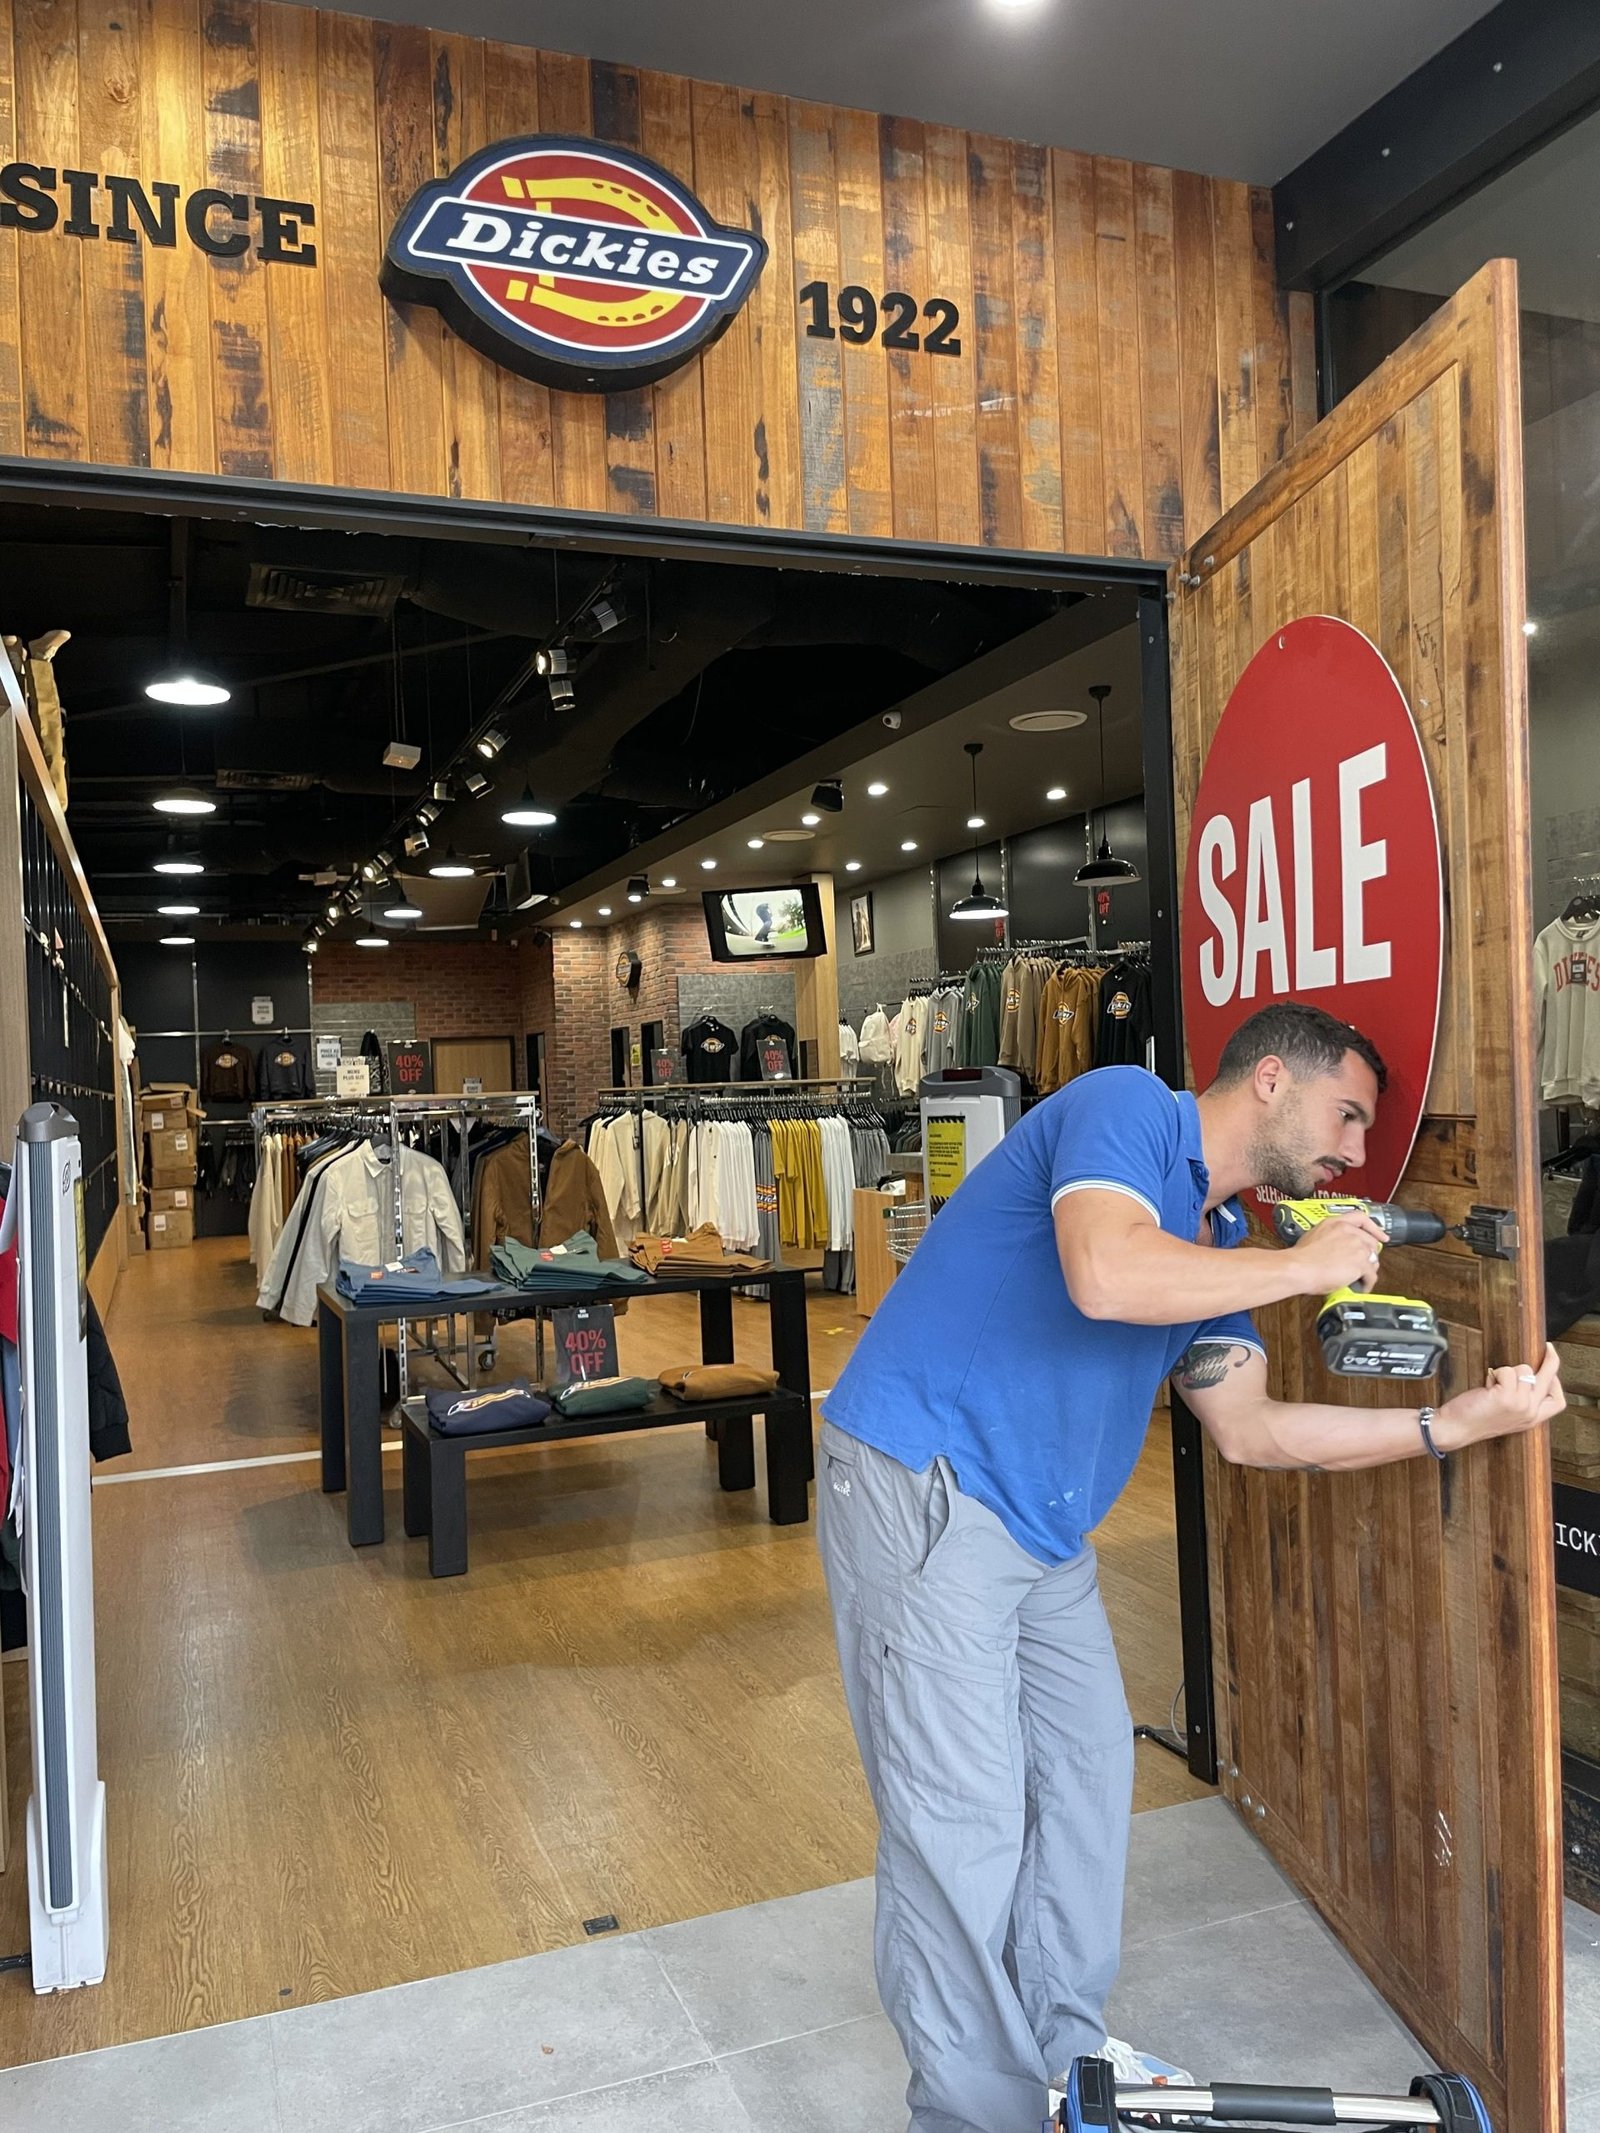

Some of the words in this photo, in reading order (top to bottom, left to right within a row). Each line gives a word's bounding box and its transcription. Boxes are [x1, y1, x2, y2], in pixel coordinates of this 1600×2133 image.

[0, 162, 317, 267] SINCE
[446, 212, 720, 285] Dickies
[799, 281, 962, 356] 1922
[1198, 742, 1392, 1007] SALE
[1553, 952, 1600, 992] DIES
[395, 1054, 424, 1068] 40%
[656, 1058, 674, 1069] 40%
[764, 1049, 784, 1061] 40%
[767, 1060, 784, 1072] OFF
[399, 1068, 423, 1082] OFF
[658, 1068, 673, 1077] OFF
[565, 1328, 607, 1351] 40%
[570, 1351, 604, 1375] OFF
[1555, 1522, 1600, 1556] ICK
